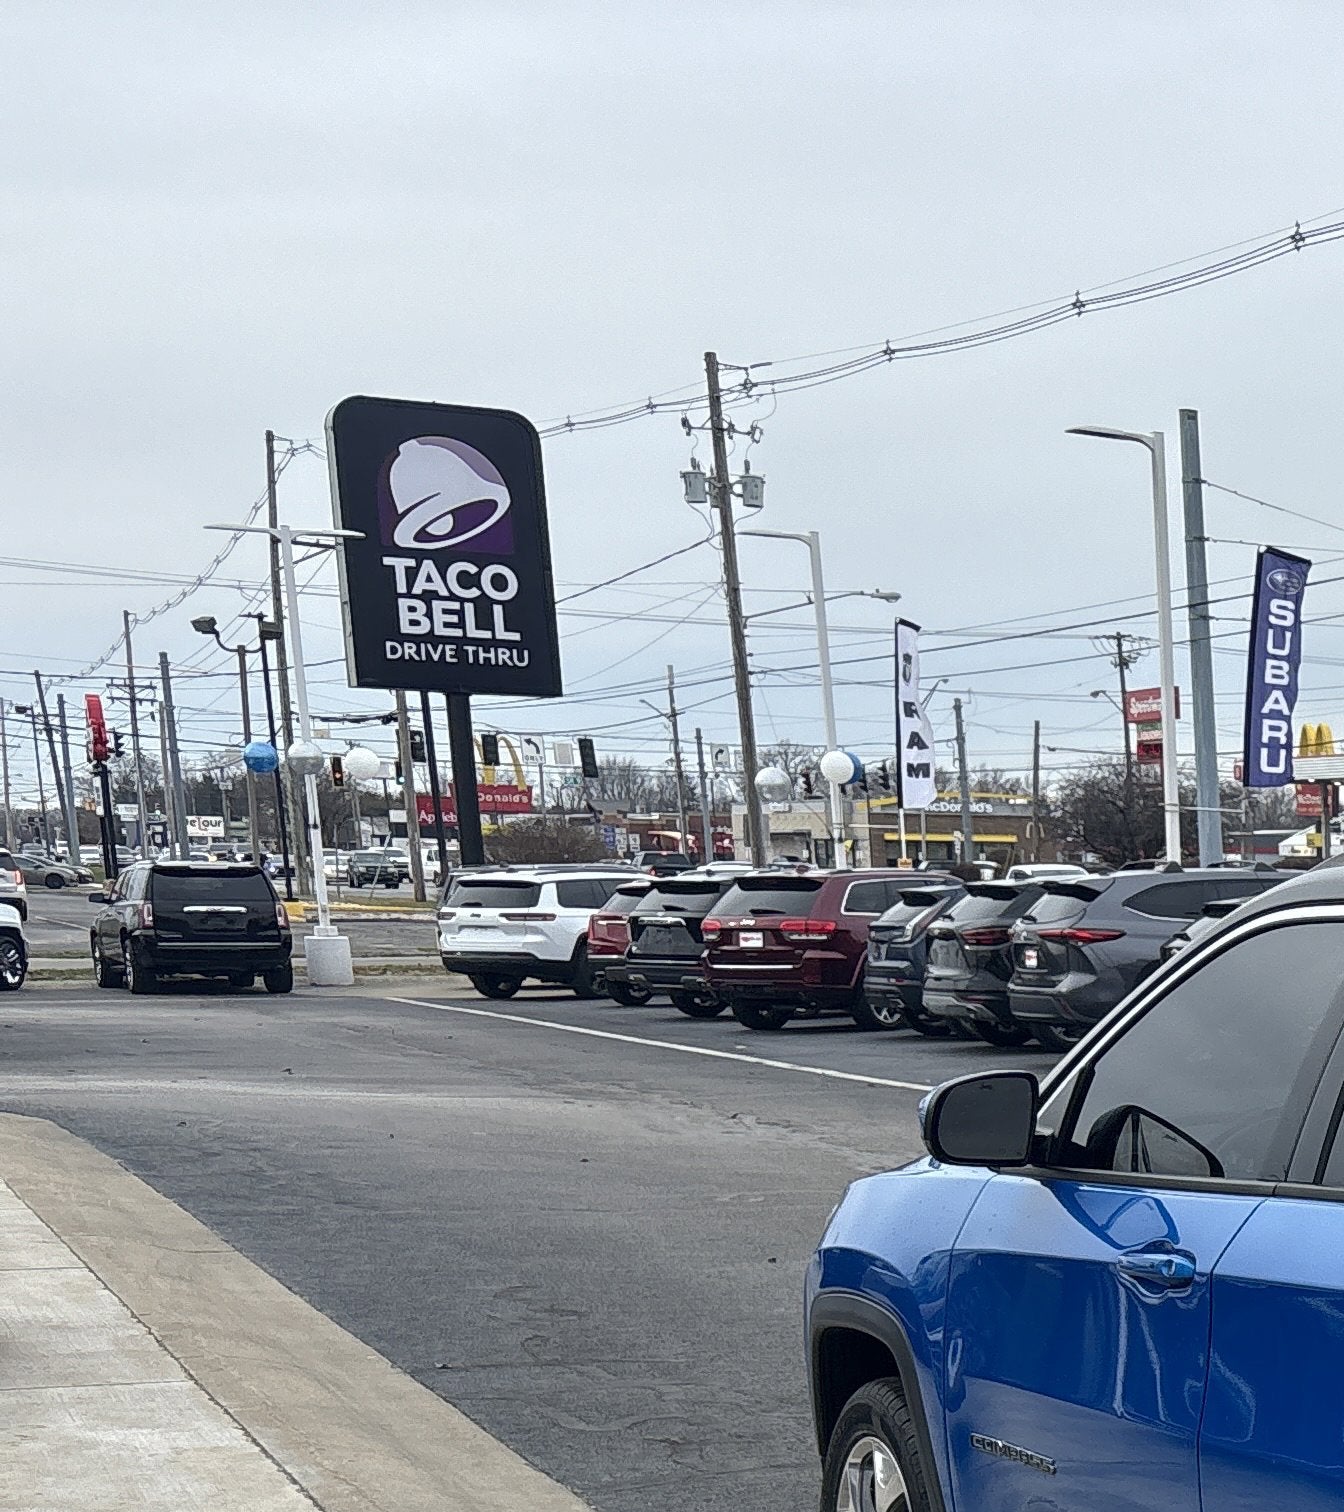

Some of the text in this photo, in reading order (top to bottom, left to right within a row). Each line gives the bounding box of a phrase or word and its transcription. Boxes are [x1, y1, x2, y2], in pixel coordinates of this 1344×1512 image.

[382, 556, 519, 601] TACO
[397, 598, 522, 642] BELL
[385, 640, 529, 667] DRIVE THRU
[1260, 599, 1296, 774] SUBARU
[903, 700, 931, 779] RAM
[477, 791, 529, 804] Donald's
